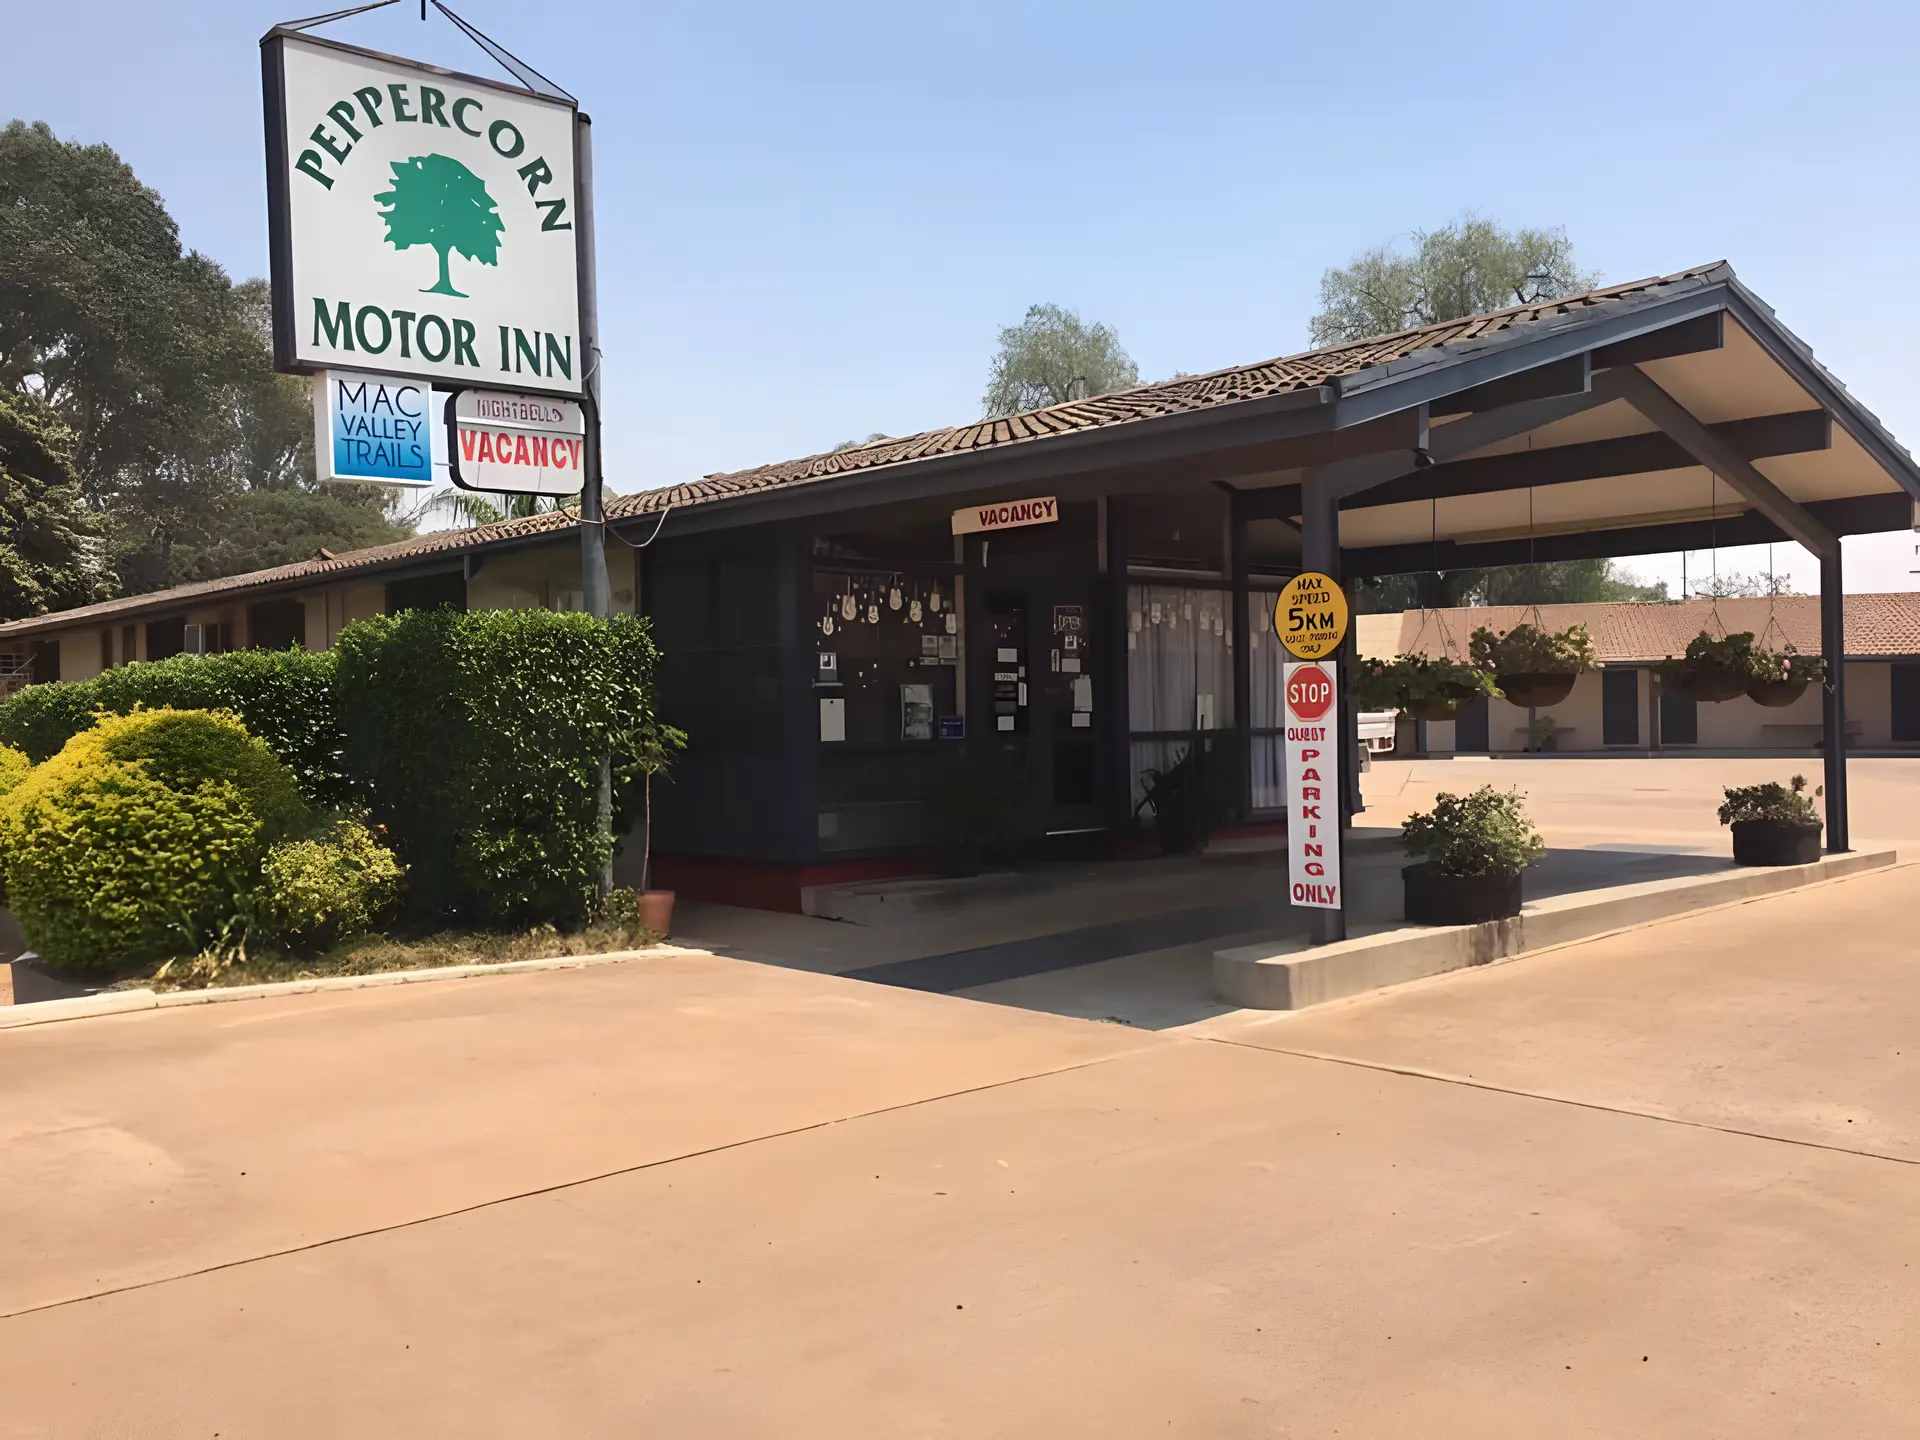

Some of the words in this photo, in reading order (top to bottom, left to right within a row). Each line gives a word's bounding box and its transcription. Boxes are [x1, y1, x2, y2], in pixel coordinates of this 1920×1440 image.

[294, 83, 573, 232] PEPPERCORN
[311, 297, 481, 369] MOTOR
[498, 325, 572, 381] INN
[338, 379, 422, 418] MAC
[340, 413, 422, 441] VALLEY
[341, 437, 424, 469] TRAILS
[458, 428, 582, 471] VACANCY
[979, 500, 1055, 526] VACANCY
[1289, 682, 1330, 704] STOP
[1301, 748, 1325, 877] PARKING
[1292, 882, 1337, 905] ONLY
